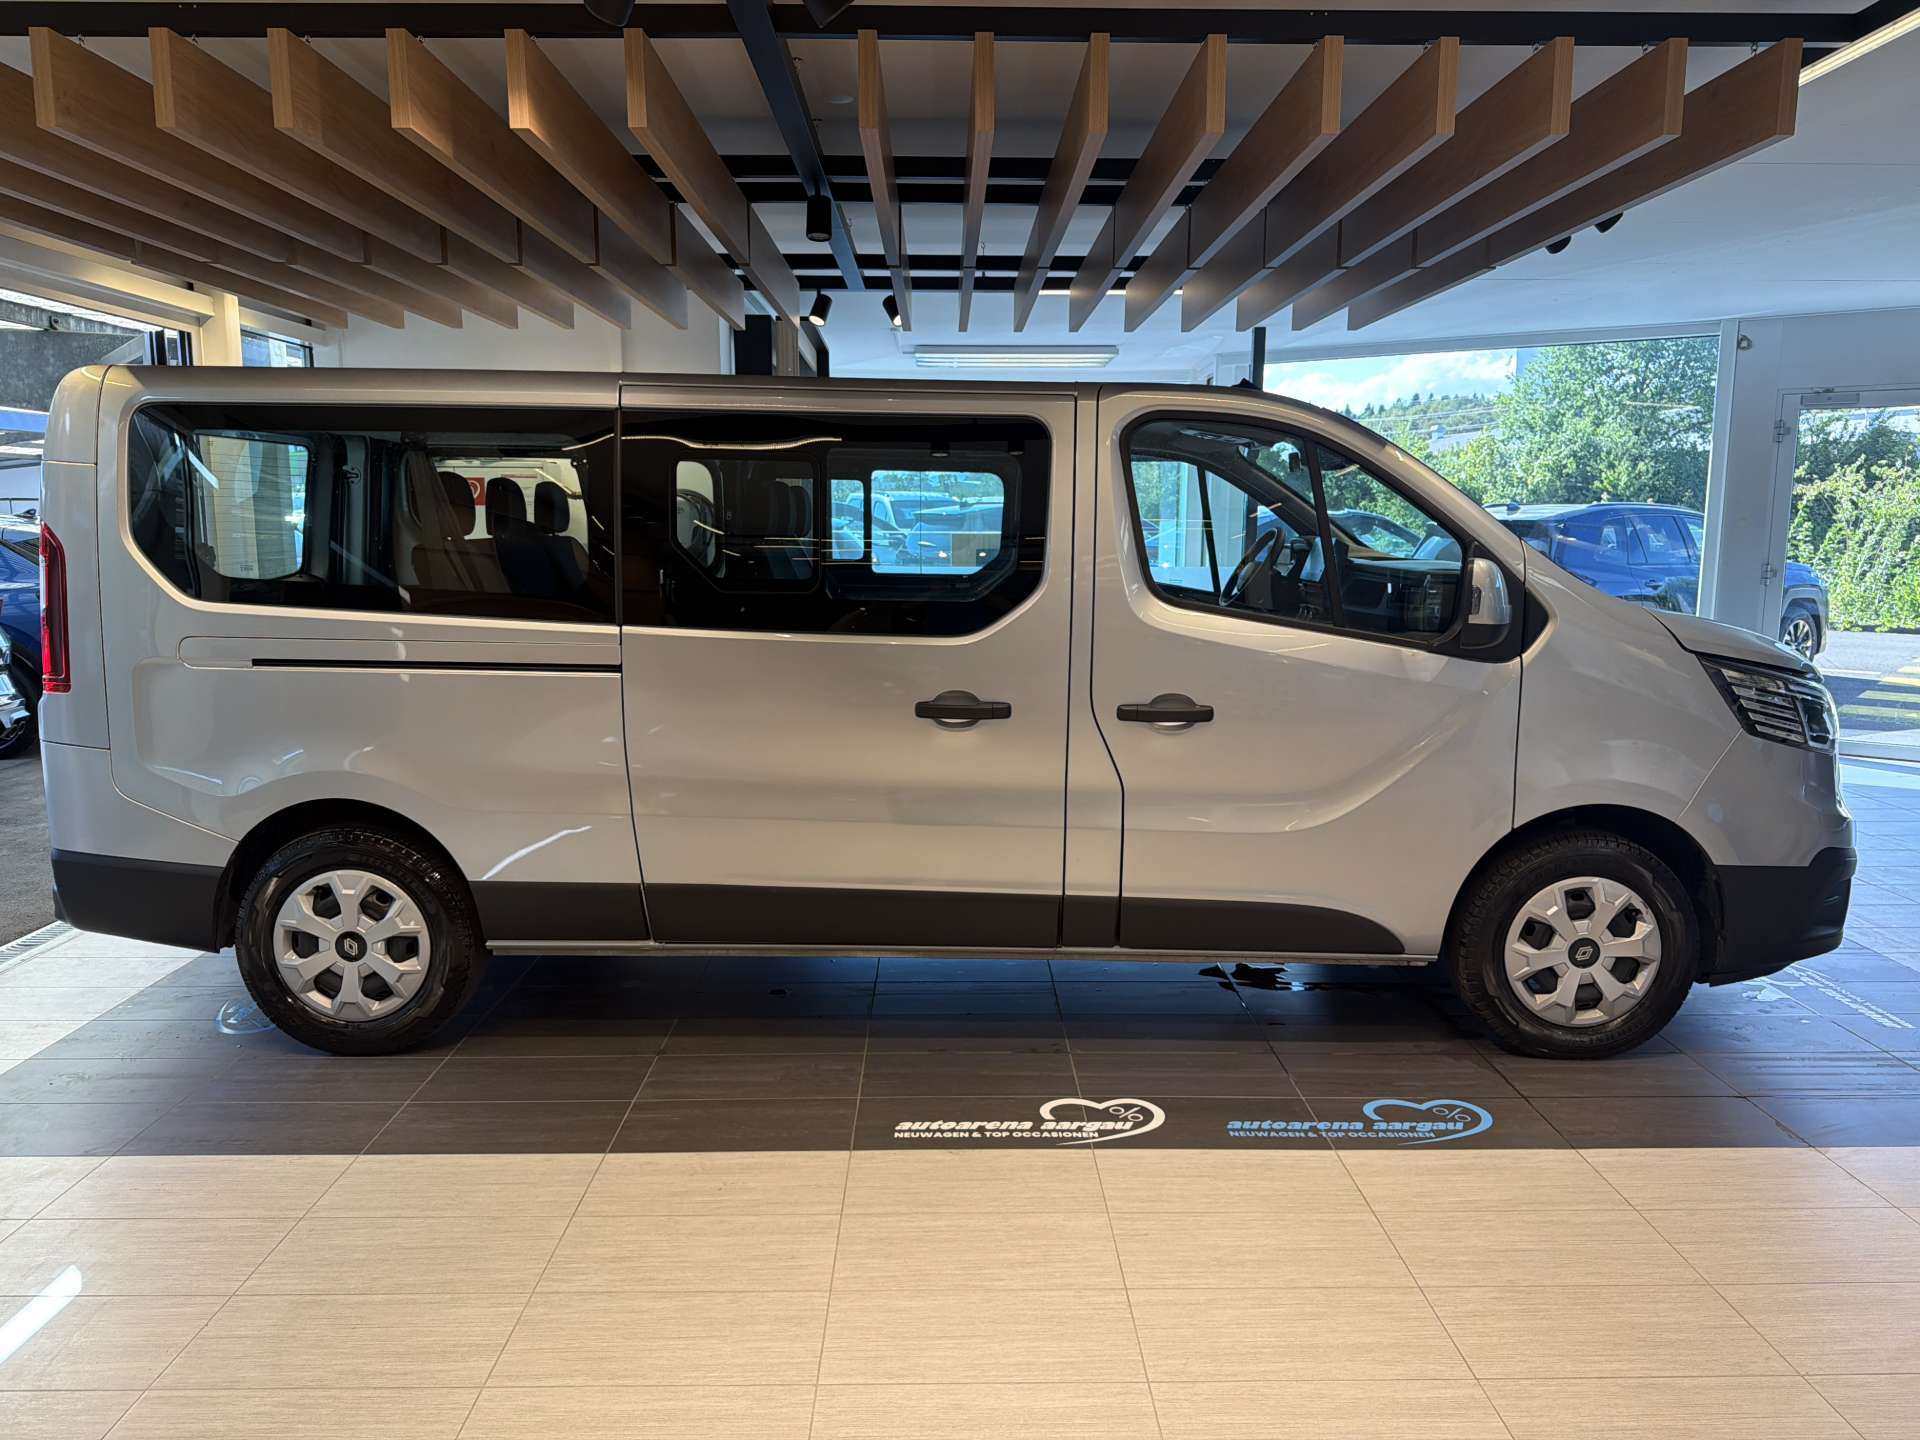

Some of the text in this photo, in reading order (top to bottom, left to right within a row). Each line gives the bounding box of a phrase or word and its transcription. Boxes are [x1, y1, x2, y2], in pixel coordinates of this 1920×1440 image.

[895, 1119, 1135, 1132] autoarena aargau
[1227, 1119, 1465, 1131] autoarena aargau
